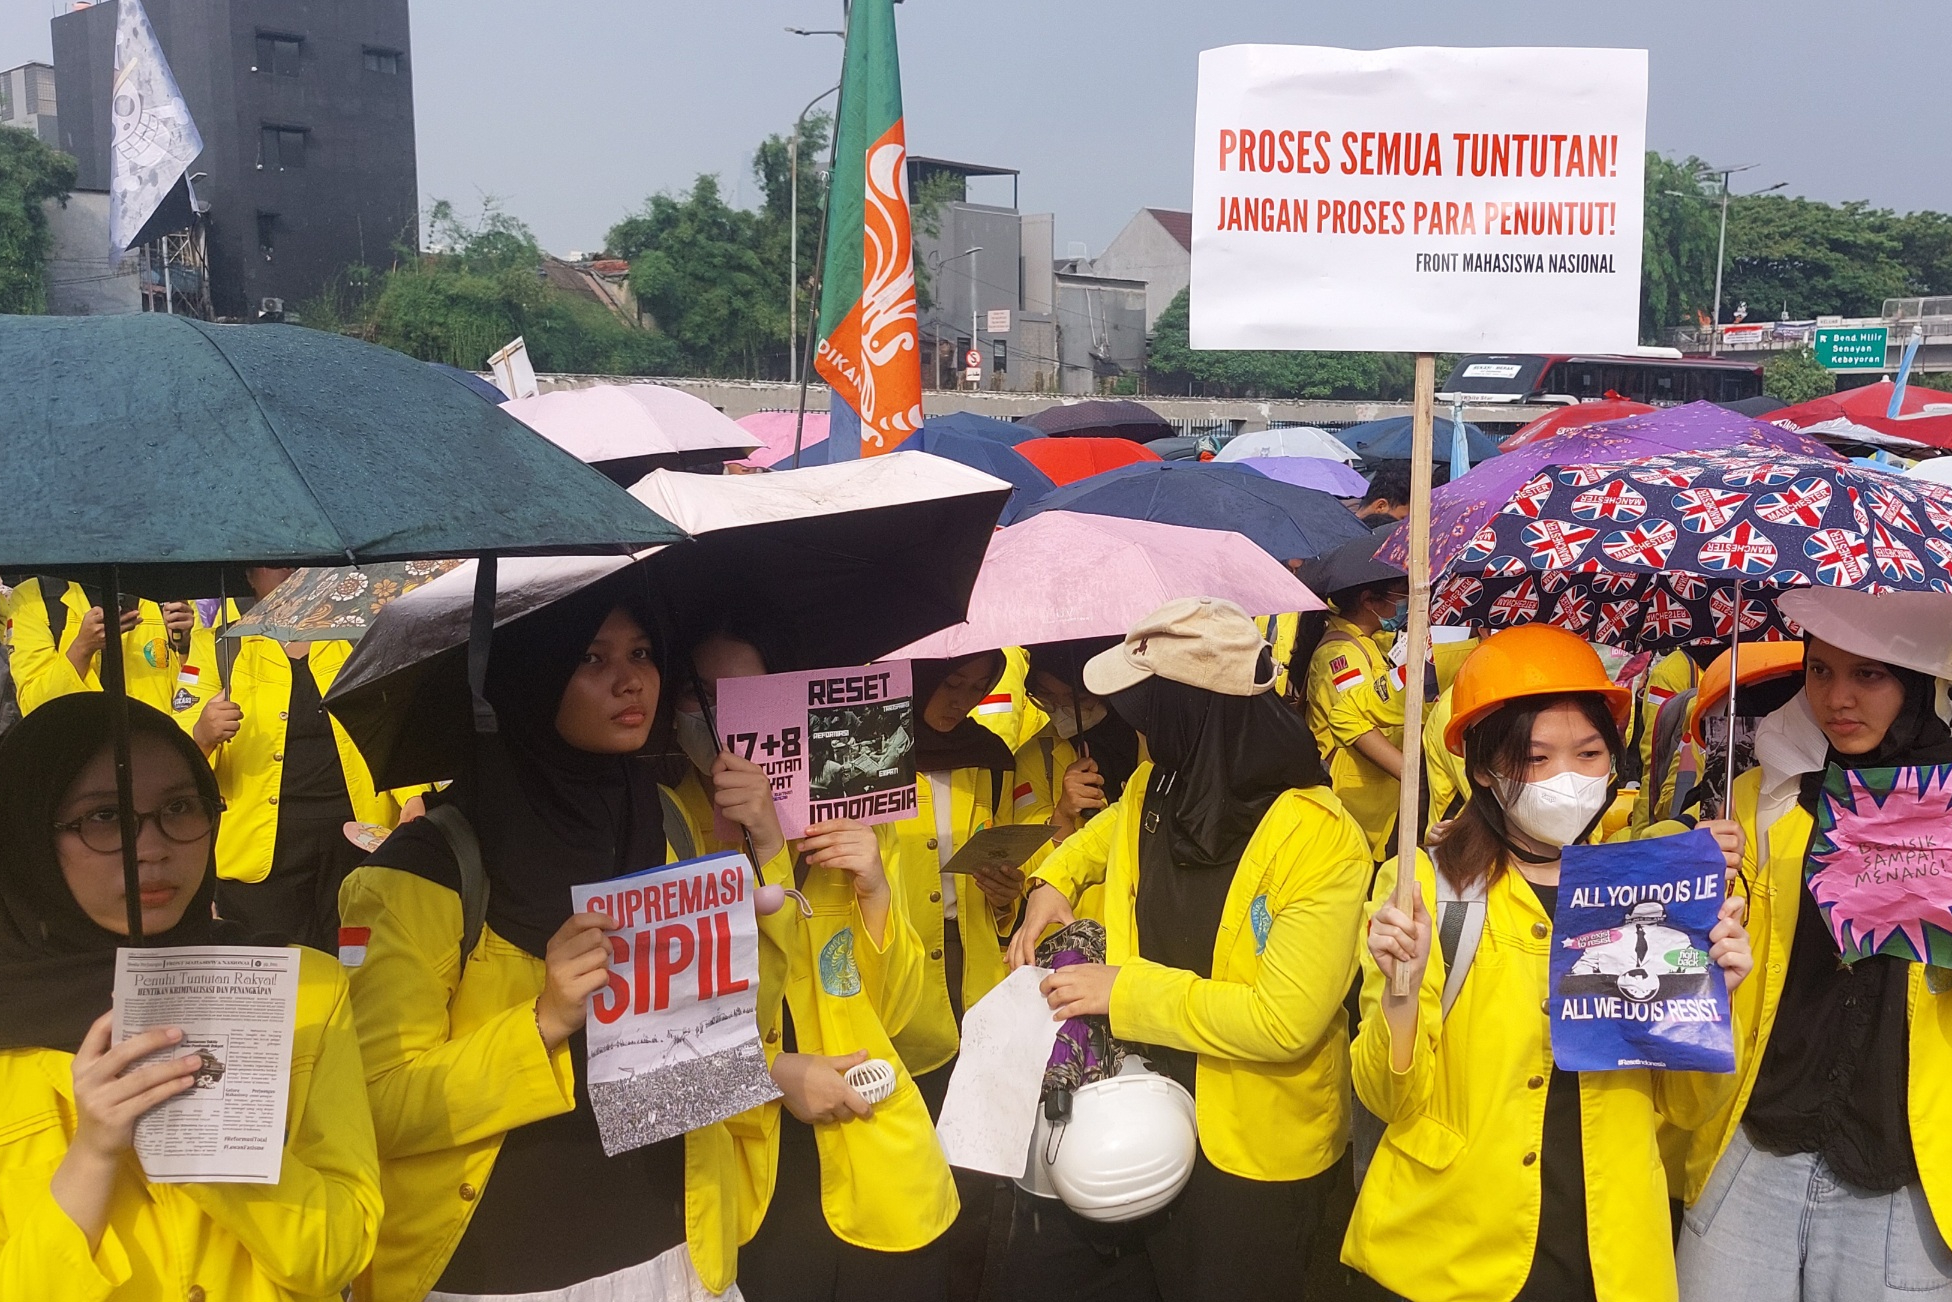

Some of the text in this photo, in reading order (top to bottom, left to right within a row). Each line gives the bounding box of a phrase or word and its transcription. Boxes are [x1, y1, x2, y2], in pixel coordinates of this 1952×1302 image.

[1219, 129, 1618, 178] PROSES SEMUA TUNTUTAN!
[1217, 196, 1616, 236] JANGAN PROSES PARA PENUNTUT!
[1416, 252, 1616, 274] FRONT MAHASISWA NASIONAL
[1831, 355, 1880, 365] Kebayoran
[1832, 344, 1872, 354] Senayan
[1580, 494, 1643, 506] MANCHESTER
[1767, 489, 1829, 521] MANCHESTER
[1615, 532, 1676, 558] MANCHESTER
[1707, 543, 1773, 553] MANCHESTER
[1829, 530, 1861, 581] MANCHESTER
[808, 672, 890, 706] RESET
[727, 726, 801, 761] 17+8
[758, 758, 802, 775] TUTAN
[809, 787, 917, 825] INDONESIA
[1855, 859, 1946, 887] MENANG!
[1570, 874, 1719, 909] ALL YOU DO IS LIE
[134, 972, 277, 987] Penuhi Tuntutan Rakyat!
[592, 912, 749, 1025] SIPIL
[137, 986, 272, 996] HENTIKAN KRIMINALISASI DAN PENANGKAPAN
[1561, 998, 1594, 1021] ALL
[1594, 997, 1622, 1019] WE
[1624, 1002, 1649, 1022] DO
[1650, 1001, 1665, 1021] IS
